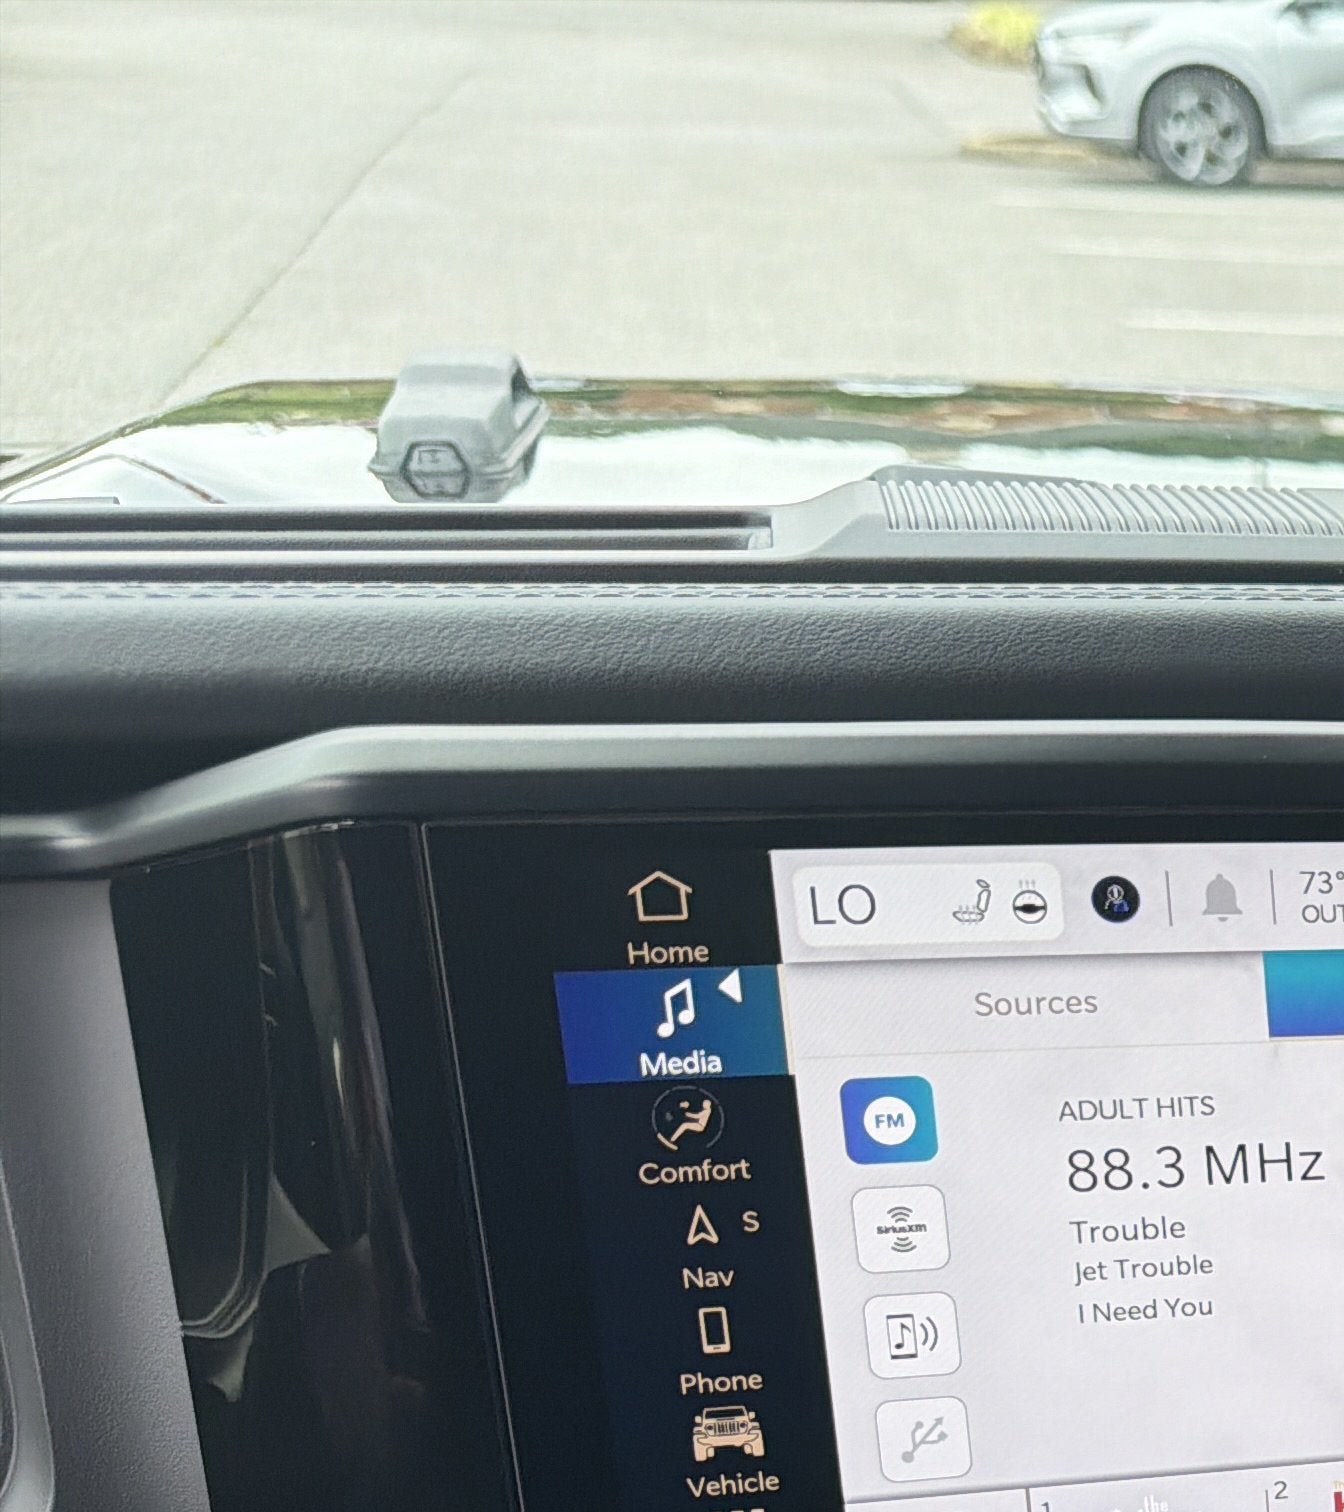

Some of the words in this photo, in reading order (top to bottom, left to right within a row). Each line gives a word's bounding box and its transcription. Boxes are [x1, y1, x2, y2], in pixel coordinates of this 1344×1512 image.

[809, 884, 877, 927] LO
[626, 940, 710, 966] Home
[974, 989, 1098, 1020] Sources
[640, 1050, 723, 1077] Media
[874, 1113, 905, 1129] FM
[1058, 1098, 1147, 1122] ADULT
[1156, 1095, 1216, 1119] HITS
[638, 1159, 752, 1184] Comfort
[1067, 1145, 1187, 1193] 88.3
[1204, 1141, 1326, 1186] MHz
[742, 1211, 760, 1233] S
[1069, 1216, 1187, 1244] Trouble
[682, 1268, 734, 1289] Nav
[1075, 1261, 1107, 1287] Jet
[1114, 1255, 1214, 1281] Trouble
[1078, 1304, 1085, 1323] I
[1093, 1299, 1158, 1323] Need
[1166, 1298, 1214, 1319] You
[680, 1372, 763, 1395] Phone
[686, 1471, 780, 1497] Vehicle
[1274, 1482, 1289, 1500] 2
